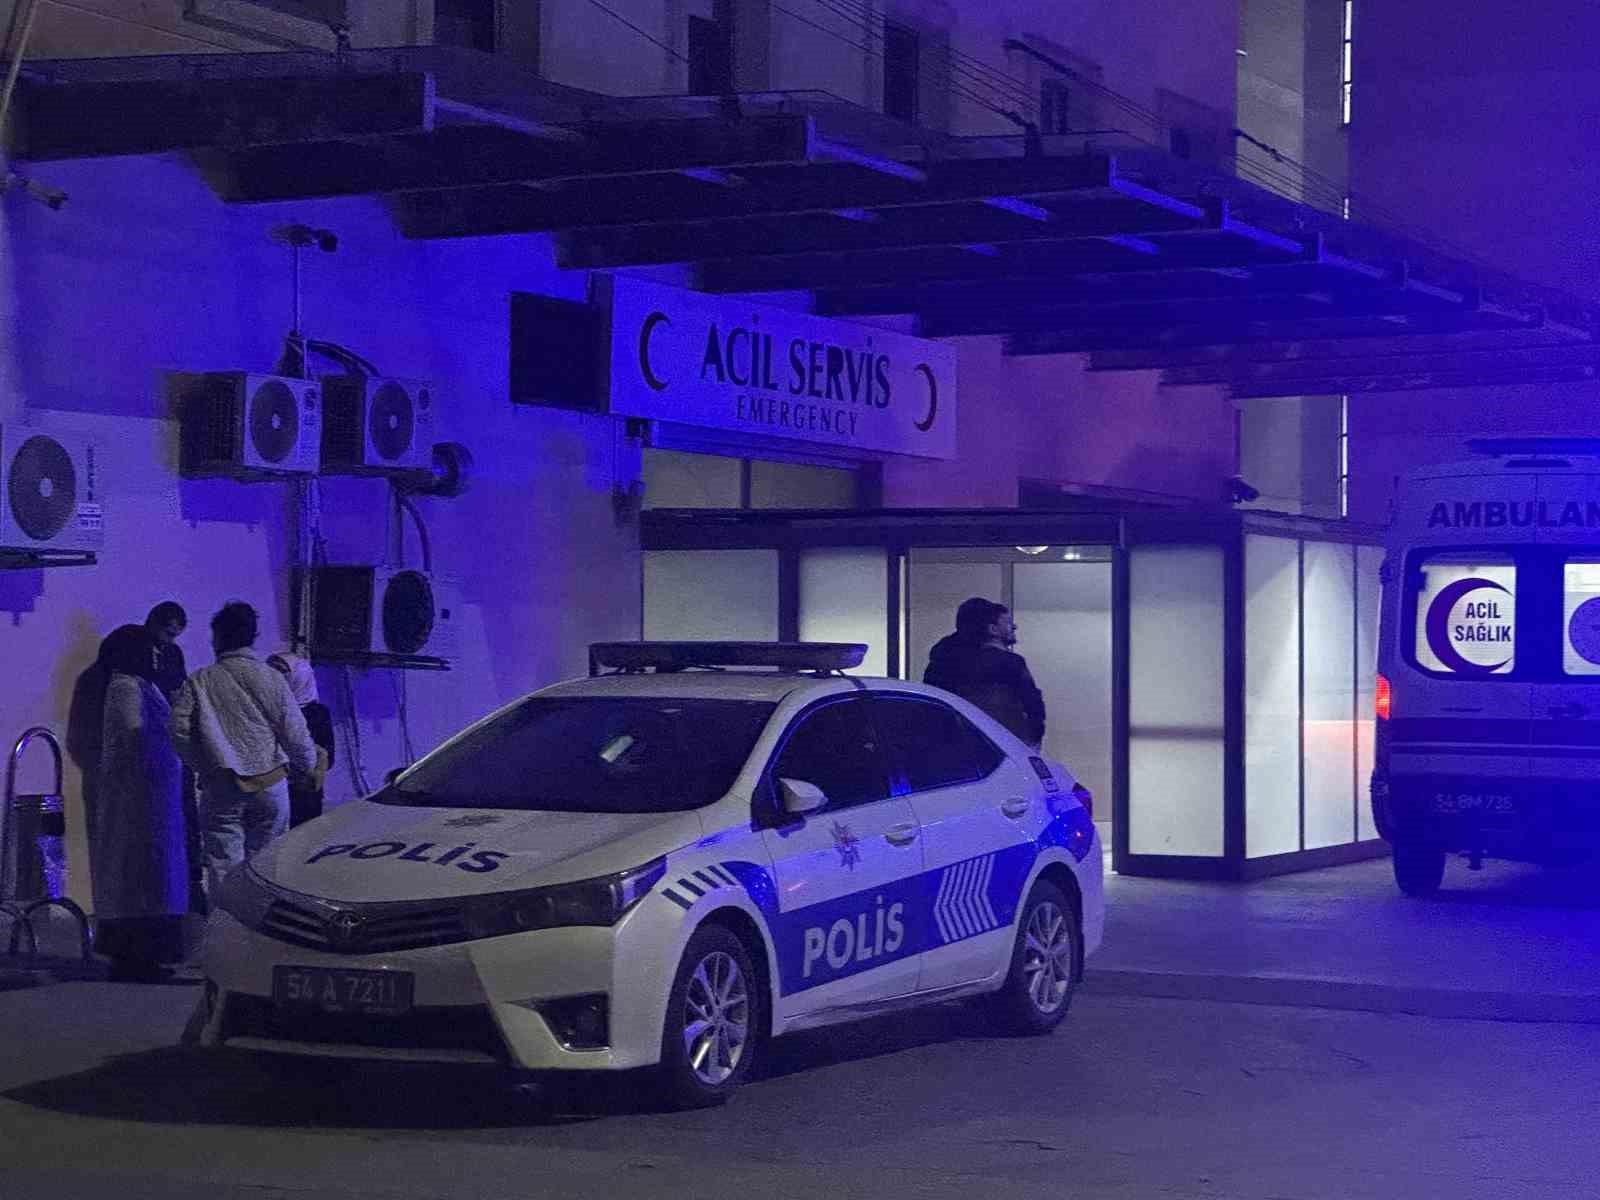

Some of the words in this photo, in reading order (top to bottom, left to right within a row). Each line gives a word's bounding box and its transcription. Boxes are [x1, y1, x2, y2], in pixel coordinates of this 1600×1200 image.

[701, 314, 778, 391] ACİL
[789, 336, 890, 409] SERVİS
[738, 396, 857, 435] EMERGENCY
[1465, 600, 1501, 619] ACİL
[1455, 622, 1512, 642] SAĞLIK
[304, 841, 510, 873] POLİS
[803, 894, 904, 978] POLİS
